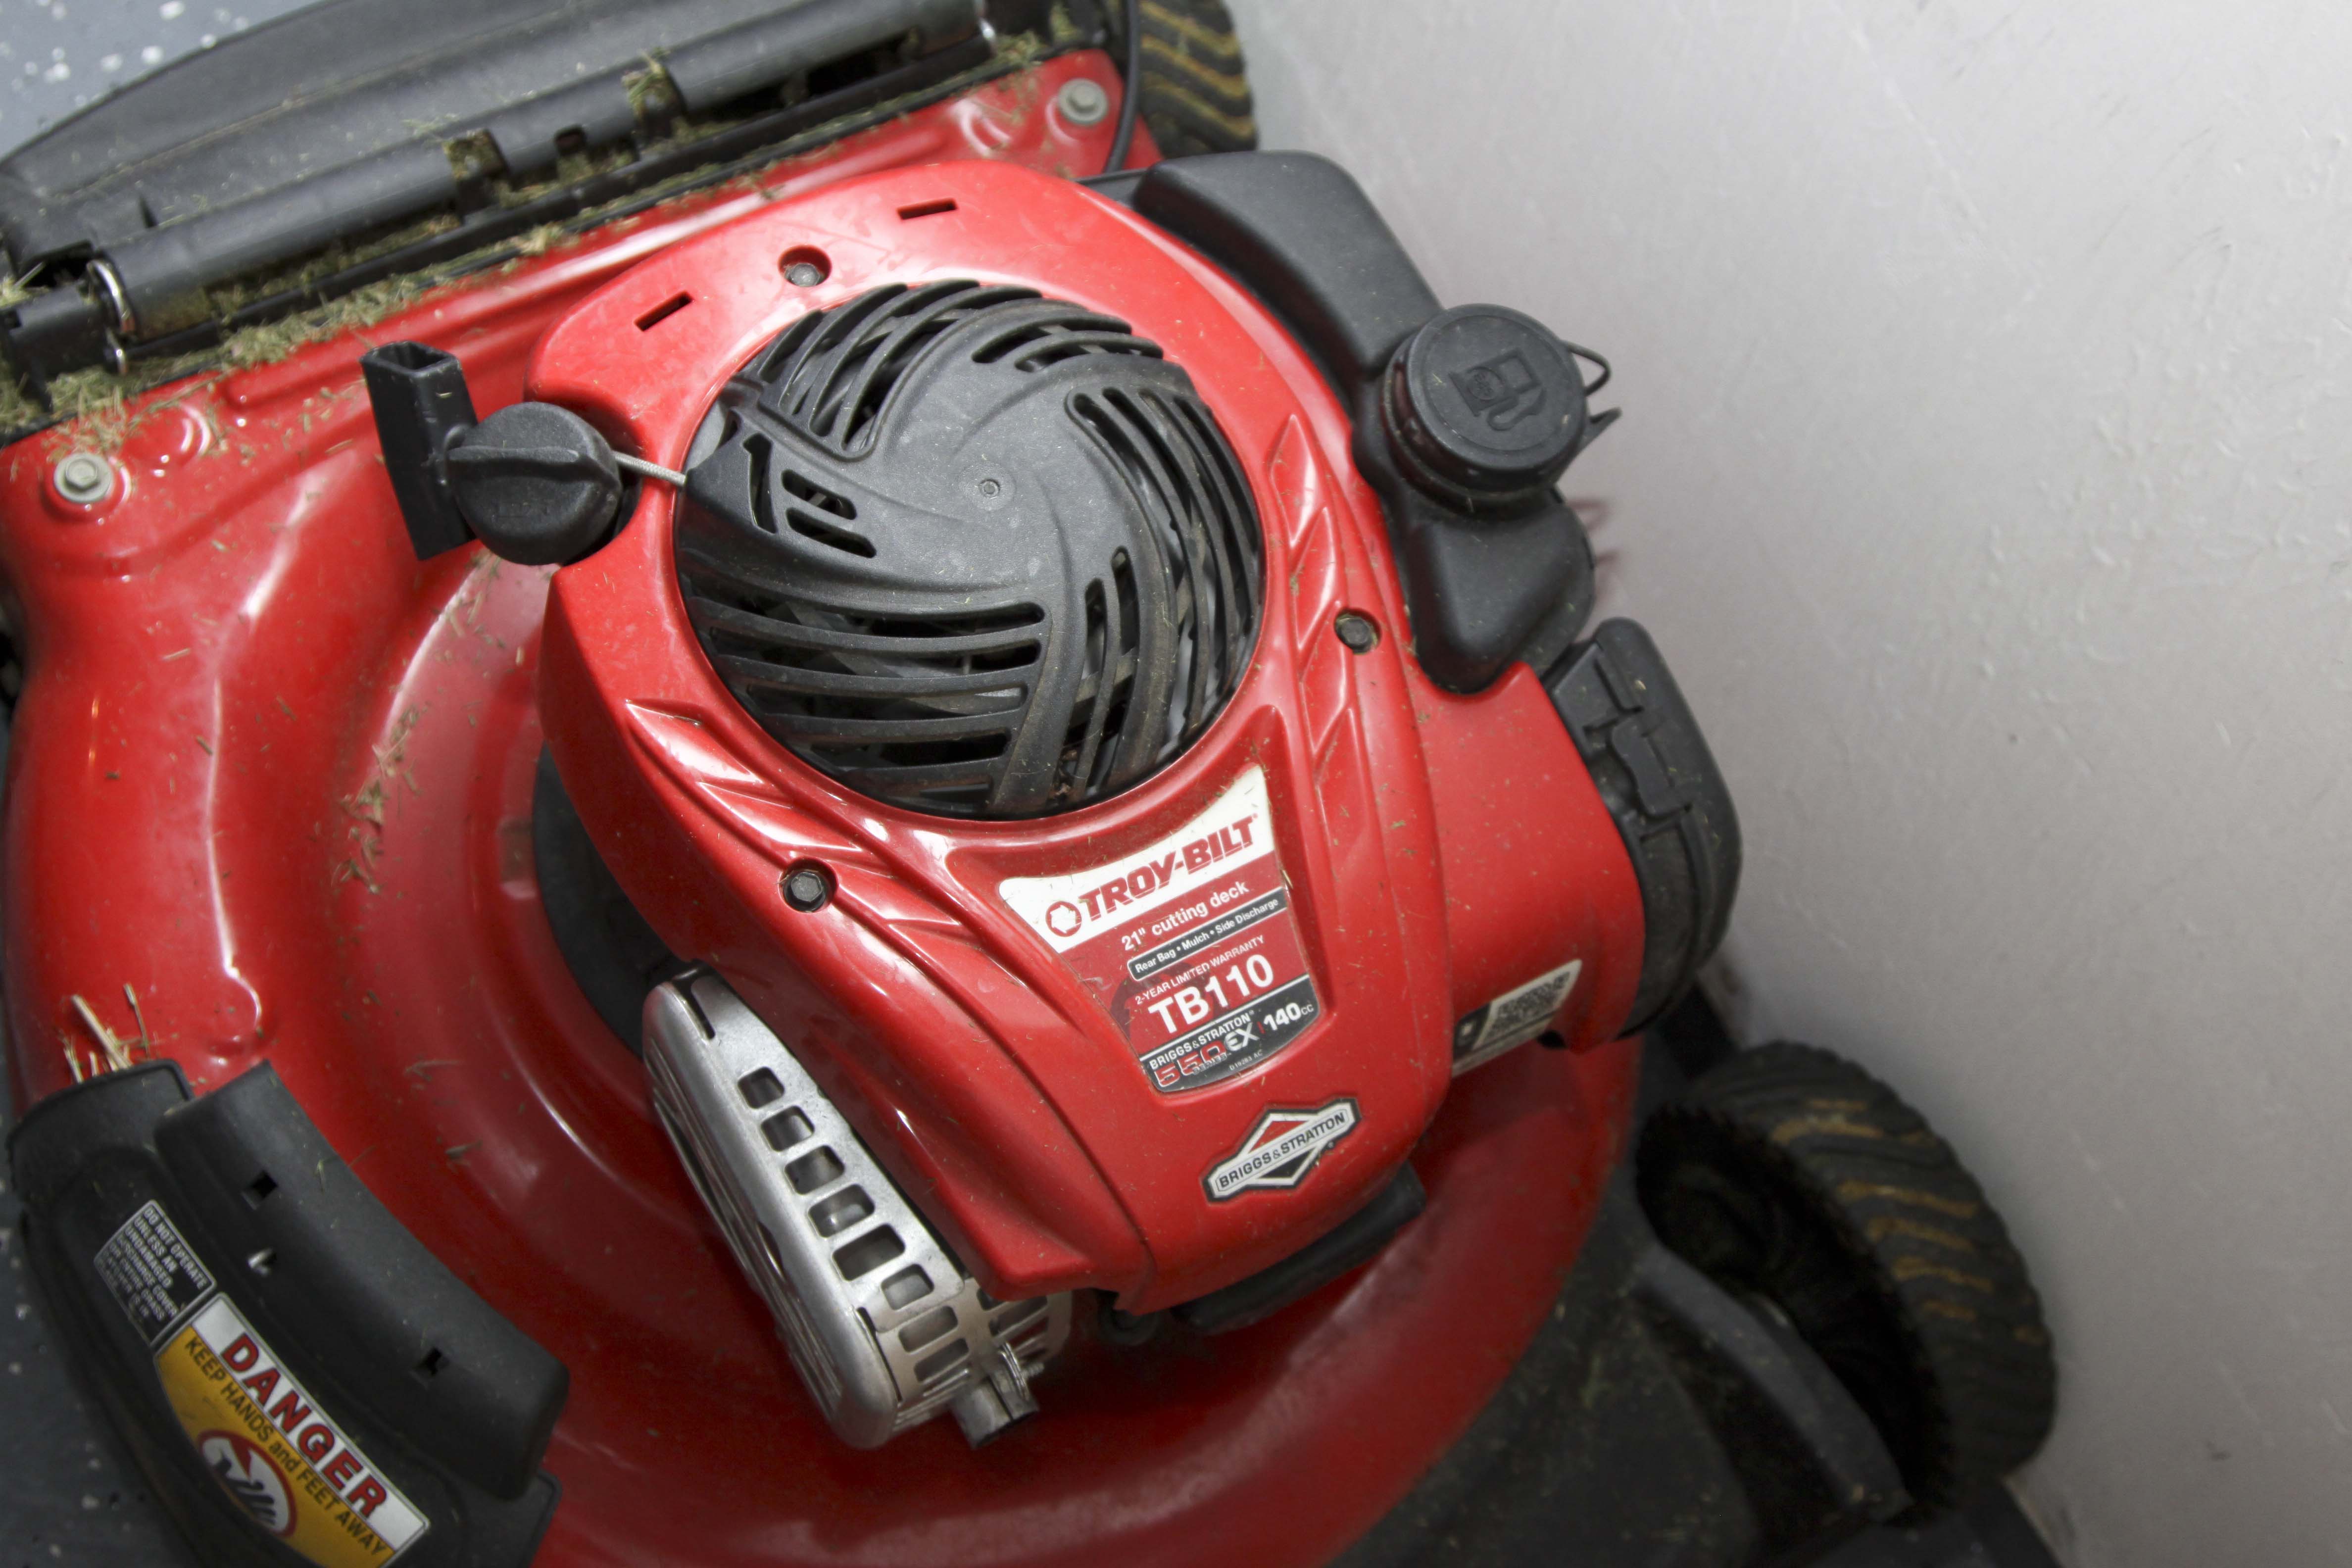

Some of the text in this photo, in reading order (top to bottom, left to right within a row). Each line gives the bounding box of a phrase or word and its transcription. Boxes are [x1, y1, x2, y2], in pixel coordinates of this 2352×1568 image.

[1078, 815, 1255, 921] TROY-BILT
[1121, 882, 1249, 951] 21" cutting deck
[1135, 899, 1278, 973] Rear Bag Mulch Side Discharge
[1135, 934, 1265, 1005] 2-YEAR LIMITED WARRANTY
[1148, 954, 1274, 1033] TB110
[124, 1225, 173, 1288] UNDAMAGED
[134, 1216, 178, 1274] UNLESS AN
[143, 1206, 208, 1289] DO NOT OPERATE
[141, 1288, 165, 1322] GRASS
[152, 1284, 178, 1318] COVER
[185, 1336, 387, 1556] KEEP HANDS and FEET AWAY
[219, 1333, 387, 1519] DANGER
